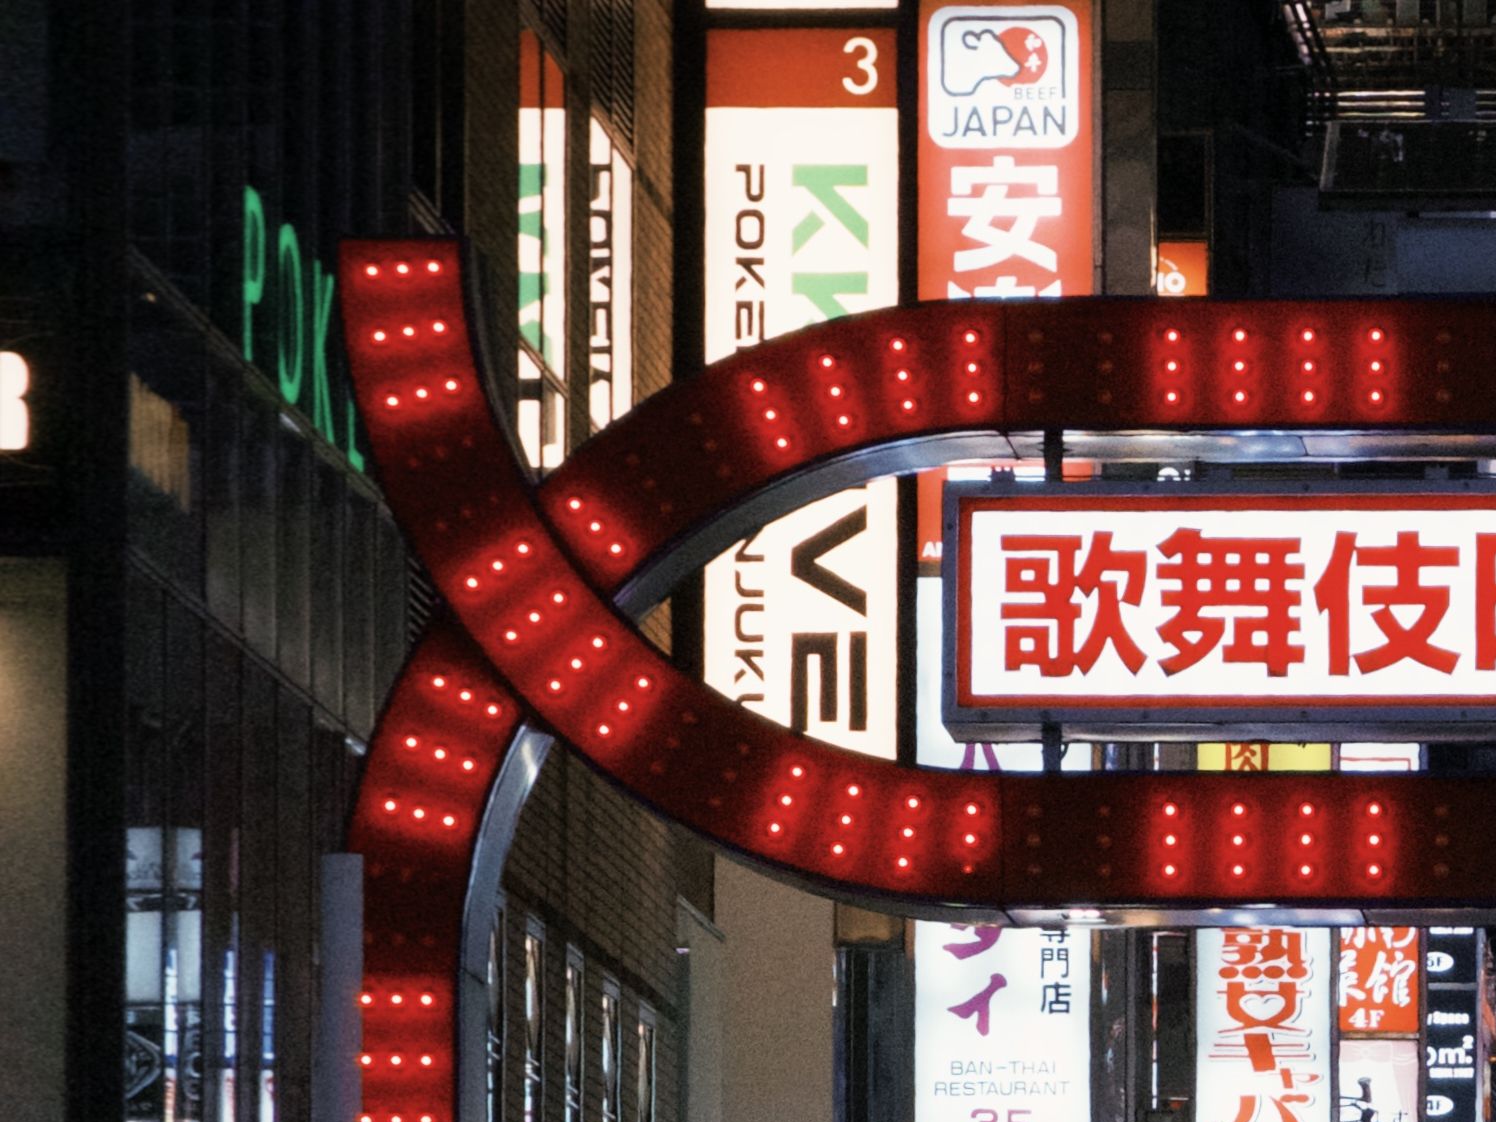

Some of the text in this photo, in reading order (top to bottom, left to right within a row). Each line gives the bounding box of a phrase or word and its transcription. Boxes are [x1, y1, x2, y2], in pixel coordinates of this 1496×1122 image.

[842, 37, 878, 94] 3
[1014, 88, 1057, 100] BEEF
[942, 106, 1066, 138] JAPAN
[947, 156, 1062, 298] 安
[735, 165, 764, 352] POKE
[951, 1061, 1056, 1076] BAN-THAI
[934, 1081, 1070, 1096] RESTAURANT
